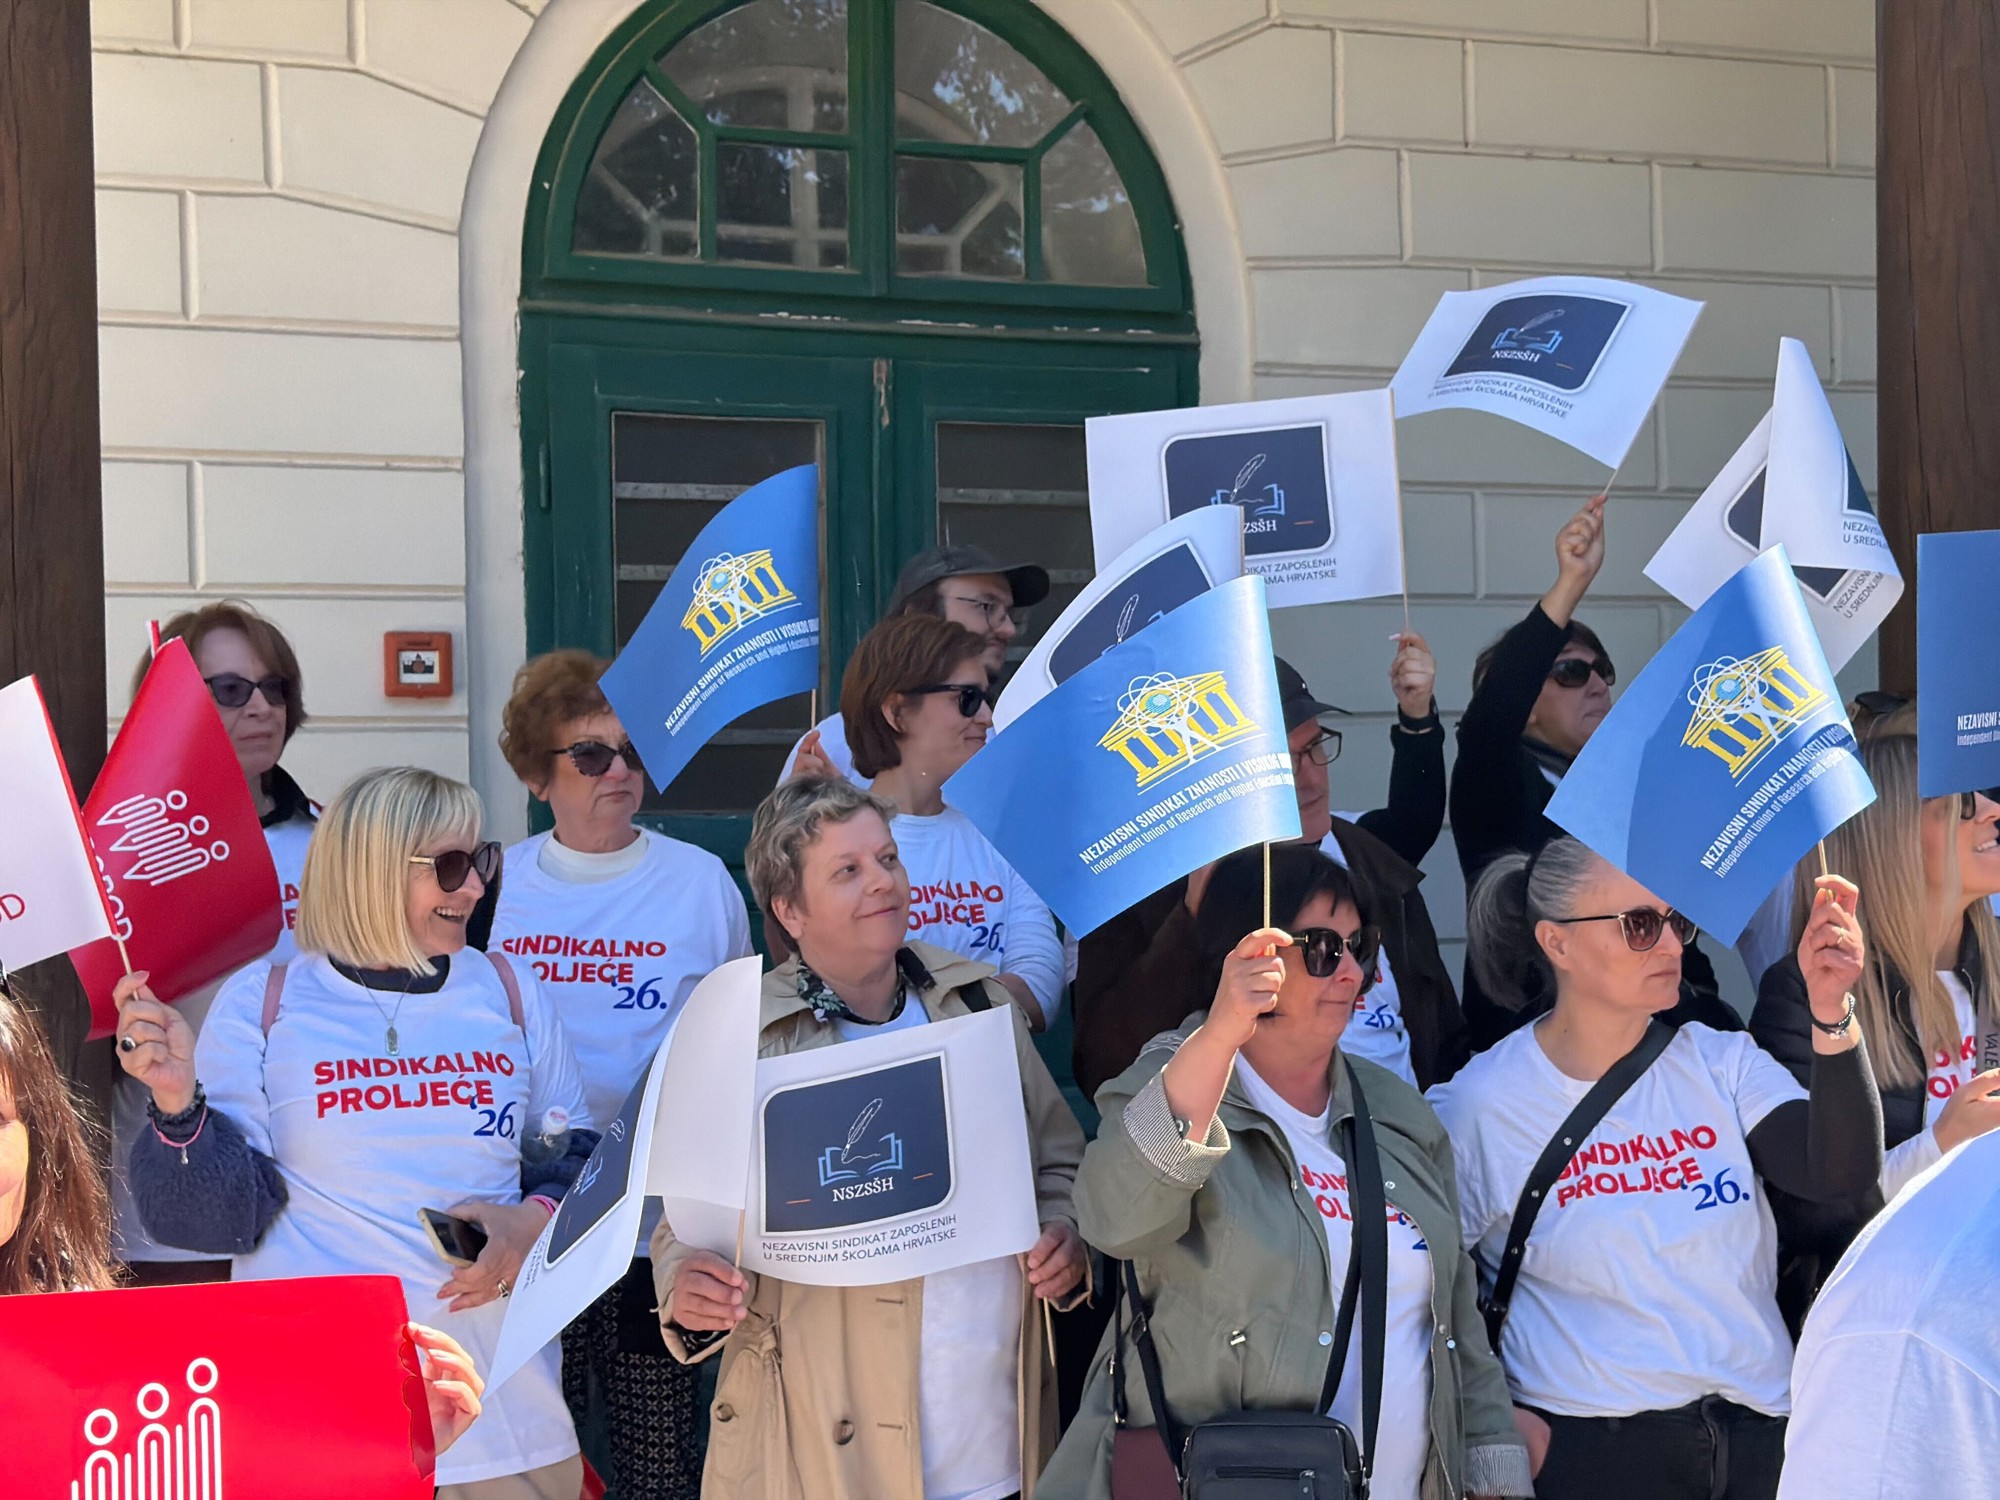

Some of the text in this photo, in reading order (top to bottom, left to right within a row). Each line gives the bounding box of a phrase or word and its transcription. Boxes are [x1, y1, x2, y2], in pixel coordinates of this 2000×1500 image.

[1515, 383, 1574, 411] ZAPOSLENIH
[1519, 394, 1569, 419] HRVATSKE
[1243, 518, 1277, 534] ZSŠH
[1843, 534, 1851, 544] U
[1245, 558, 1337, 576] DIKAT ZAPOSLENIH
[1286, 569, 1337, 583] HRVATSKE
[1843, 610, 1854, 620] U
[664, 684, 701, 730] NEZAVISNI
[697, 652, 736, 690] SINDIKAT
[732, 629, 779, 660] ZNANOSTI
[774, 627, 783, 641] I
[670, 697, 703, 737] Independent
[699, 682, 720, 701] Union
[716, 674, 727, 686] of
[723, 655, 757, 680] Research
[1957, 711, 1998, 731] NEZAVISNI
[1808, 761, 1827, 779] and
[1700, 813, 1749, 870] NEZAVISNI
[1740, 771, 1788, 819] SINDIKAT
[1778, 738, 1827, 780] ZNANOSTI
[1819, 734, 1832, 747] I
[1776, 773, 1814, 805] Research
[1078, 820, 1141, 865] NEZAVISNI
[1135, 790, 1190, 828] SINDIKAT
[1184, 765, 1241, 801] ZNANOSTI
[1234, 763, 1247, 778] I
[1769, 799, 1784, 813] of
[1090, 836, 1146, 875] Independent
[1140, 822, 1169, 843] Union
[1165, 815, 1179, 830] of
[1174, 797, 1216, 824] Research
[1213, 788, 1233, 805] and
[1227, 778, 1256, 799] Higher
[1750, 808, 1777, 833] Union
[1714, 828, 1758, 879] Independent
[909, 879, 1004, 905] DIKALNO
[907, 898, 987, 931] OLJEĆE
[502, 934, 667, 958] SINDIKALNO
[531, 957, 635, 984] OLJEĆE
[313, 1051, 516, 1086] SINDIKALNO
[316, 1073, 495, 1119] PROLJEĆE
[832, 1176, 895, 1203] NSZSŠH
[762, 1214, 958, 1252] NEZAVISNI SINDIKAT ZAPOSLENIH
[763, 1228, 957, 1263] U SREDNJIM ŠKOLAMA HRVATSKE
